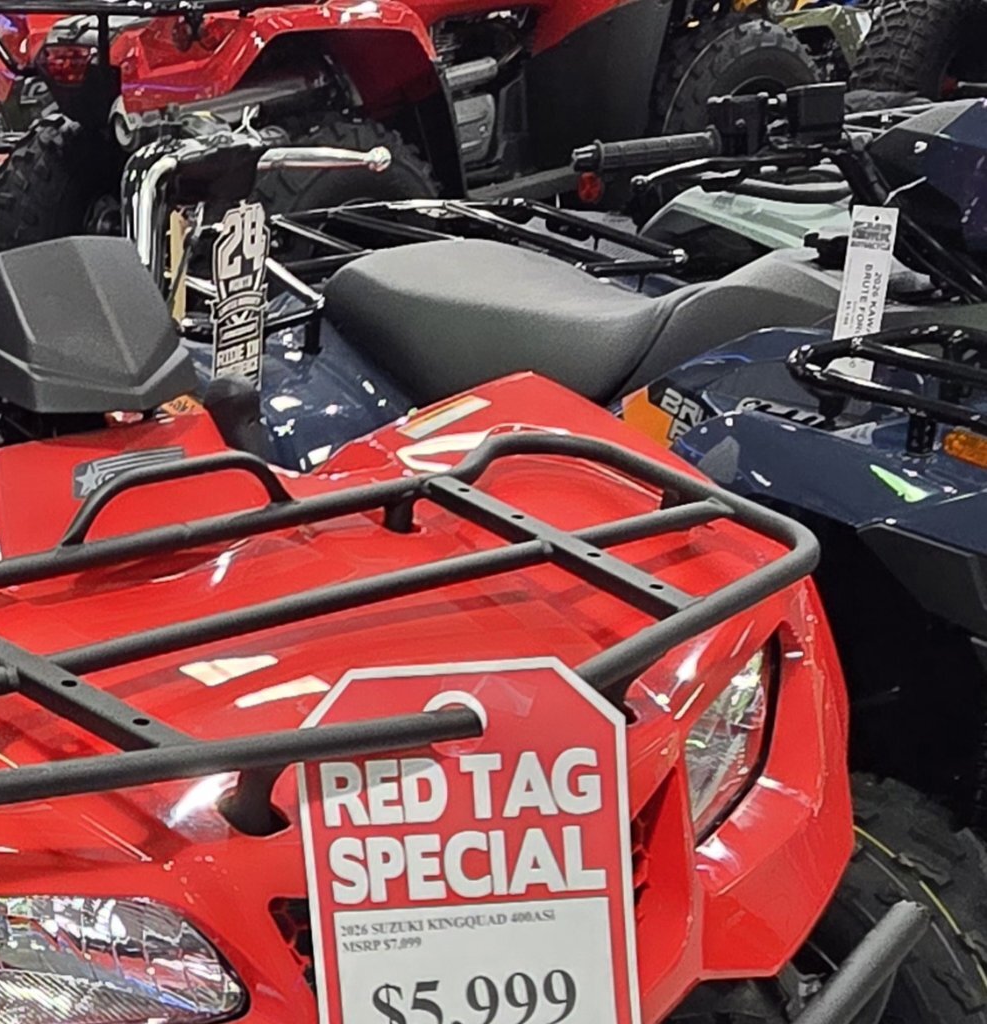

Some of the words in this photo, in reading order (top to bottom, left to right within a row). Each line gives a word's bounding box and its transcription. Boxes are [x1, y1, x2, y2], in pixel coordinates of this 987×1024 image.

[319, 757, 449, 828] RED
[459, 747, 602, 820] TAG
[328, 825, 607, 905] SPECIAL
[341, 924, 368, 937] 2026
[371, 919, 424, 935] SUZUKI
[427, 913, 508, 931] KINGQUAD
[342, 940, 381, 953] MSRP
